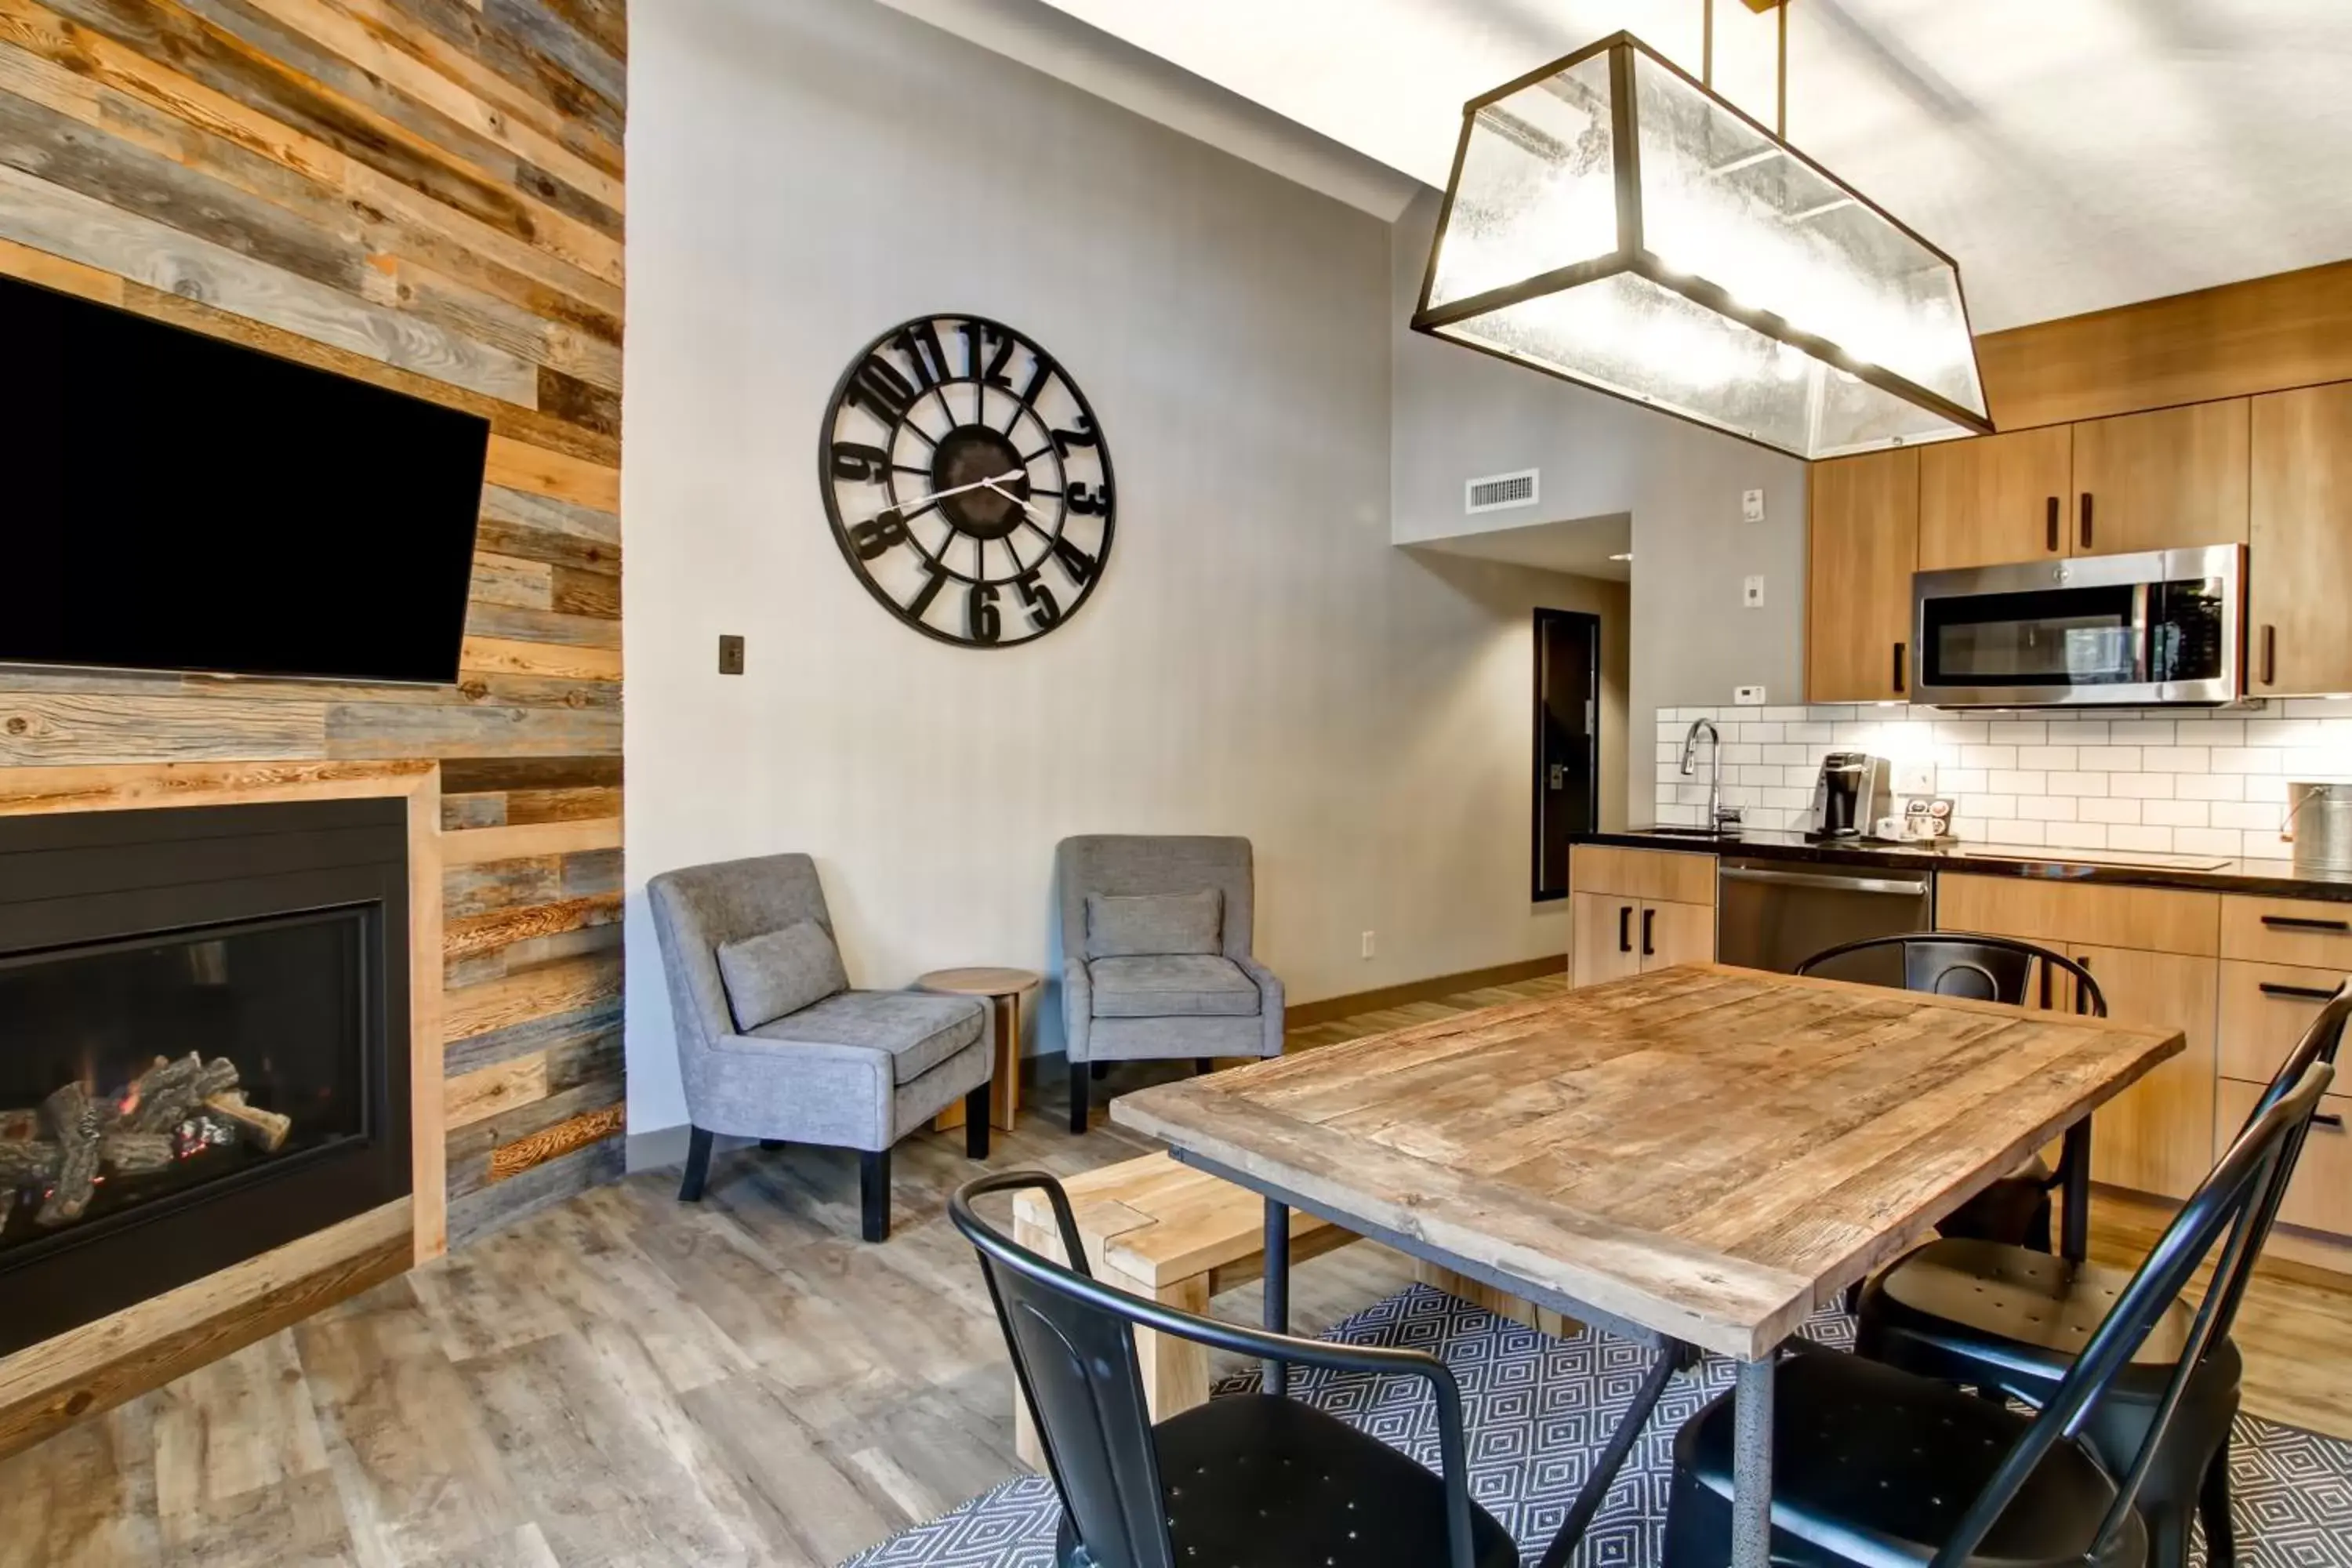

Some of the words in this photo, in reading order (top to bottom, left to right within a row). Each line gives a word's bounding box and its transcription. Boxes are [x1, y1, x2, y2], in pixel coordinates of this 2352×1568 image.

[889, 320, 951, 390] 11
[955, 320, 1014, 387] 12
[1022, 355, 1054, 408] 1
[844, 354, 915, 428] 10
[832, 441, 888, 484] 9
[1051, 415, 1098, 458] 2
[1067, 481, 1112, 517] 3
[850, 510, 908, 561] 8
[1050, 533, 1098, 586] 4
[907, 557, 947, 620] 7
[969, 583, 1001, 643] 6
[1016, 569, 1061, 630] 5
